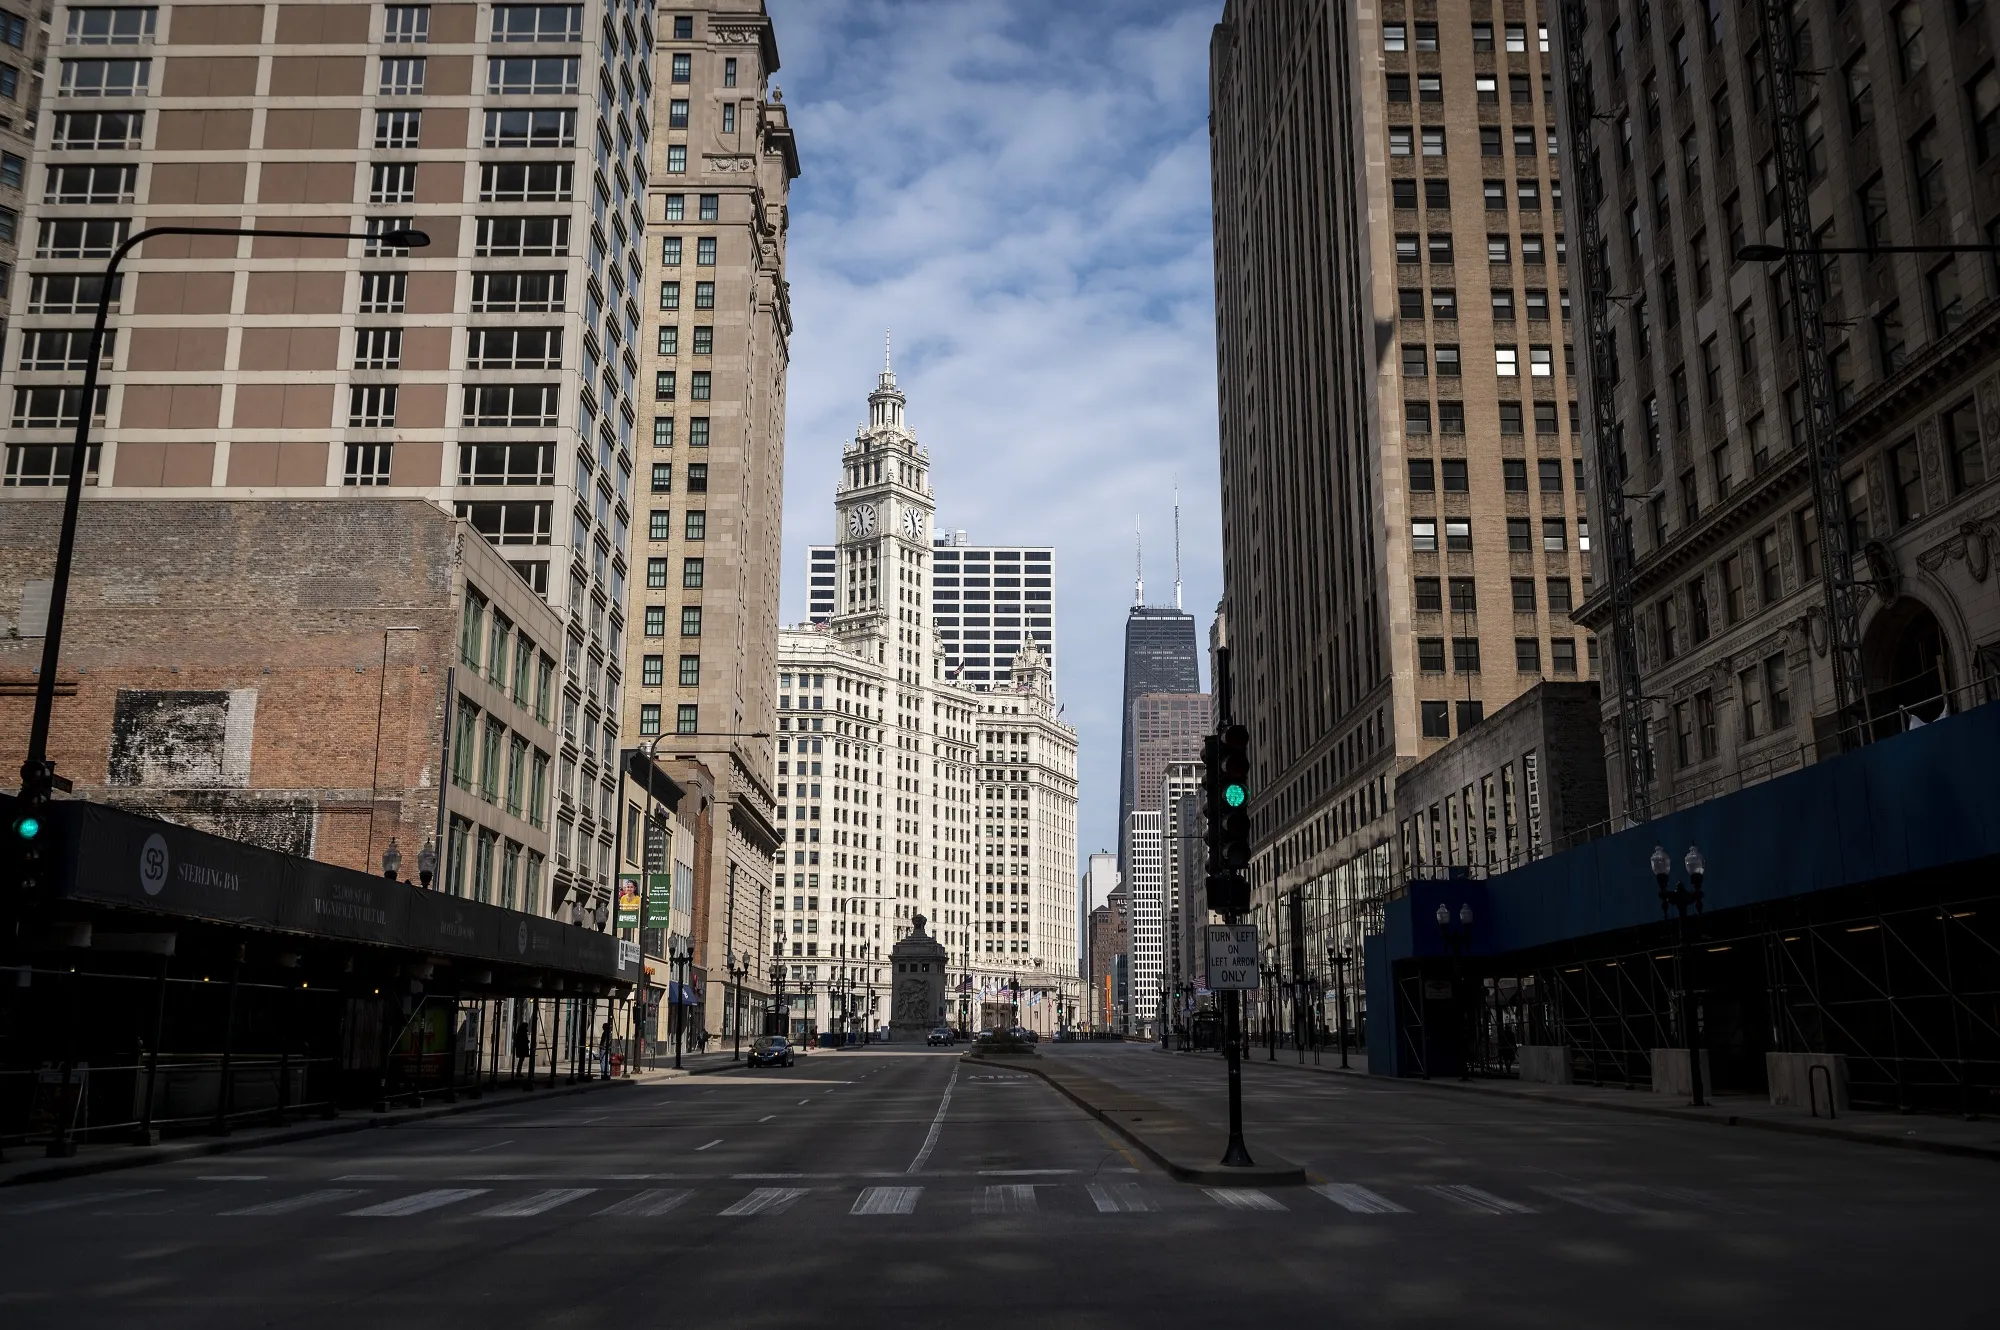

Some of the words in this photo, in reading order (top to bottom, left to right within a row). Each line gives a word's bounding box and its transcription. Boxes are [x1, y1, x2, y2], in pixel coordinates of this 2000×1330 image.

[177, 863, 222, 887] STERLING
[224, 872, 240, 892] BAY
[1210, 931, 1231, 942] TURN
[1236, 931, 1255, 942] LEFT
[1228, 945, 1239, 954] ON
[1211, 957, 1228, 967] LEFT
[1232, 957, 1255, 967] ARROW
[1221, 970, 1247, 982] ONLY
